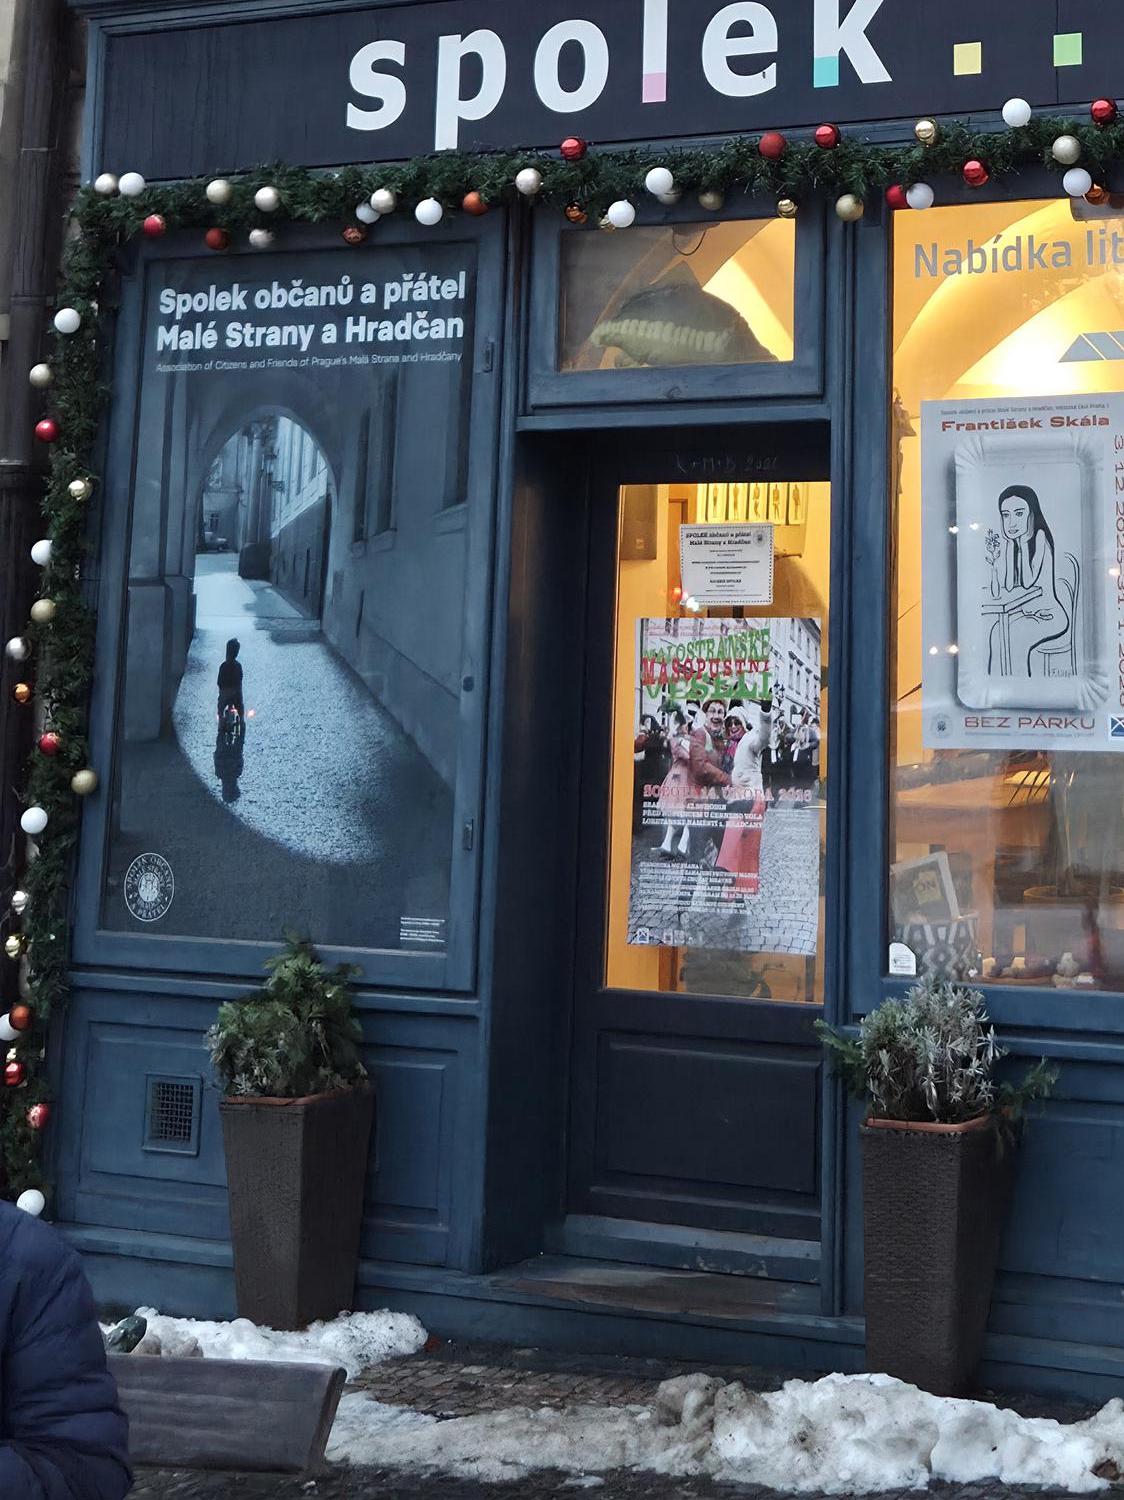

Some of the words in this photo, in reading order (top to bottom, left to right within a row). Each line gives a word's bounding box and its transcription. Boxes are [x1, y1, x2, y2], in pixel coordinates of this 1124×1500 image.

[914, 234, 1072, 279] Nabídka
[159, 284, 247, 320] Spolek
[255, 275, 354, 310] občanů
[360, 281, 377, 304] a
[383, 271, 466, 310] přátel
[157, 321, 218, 351] Malé
[225, 321, 315, 352] Strany
[321, 322, 337, 344] a
[345, 311, 464, 343] Hradčan
[156, 363, 202, 373] Association
[204, 361, 213, 371] of
[215, 360, 248, 370] Citizens
[249, 359, 265, 368] and
[267, 358, 298, 368] Friends
[299, 358, 309, 367] of
[402, 352, 418, 362] and
[942, 417, 1042, 432] František
[1050, 414, 1110, 428] Skála
[1114, 434, 1124, 455] 3.
[1114, 462, 1124, 495] 12.
[964, 716, 1011, 729] BEZ
[1018, 714, 1096, 731] PÁRKU
